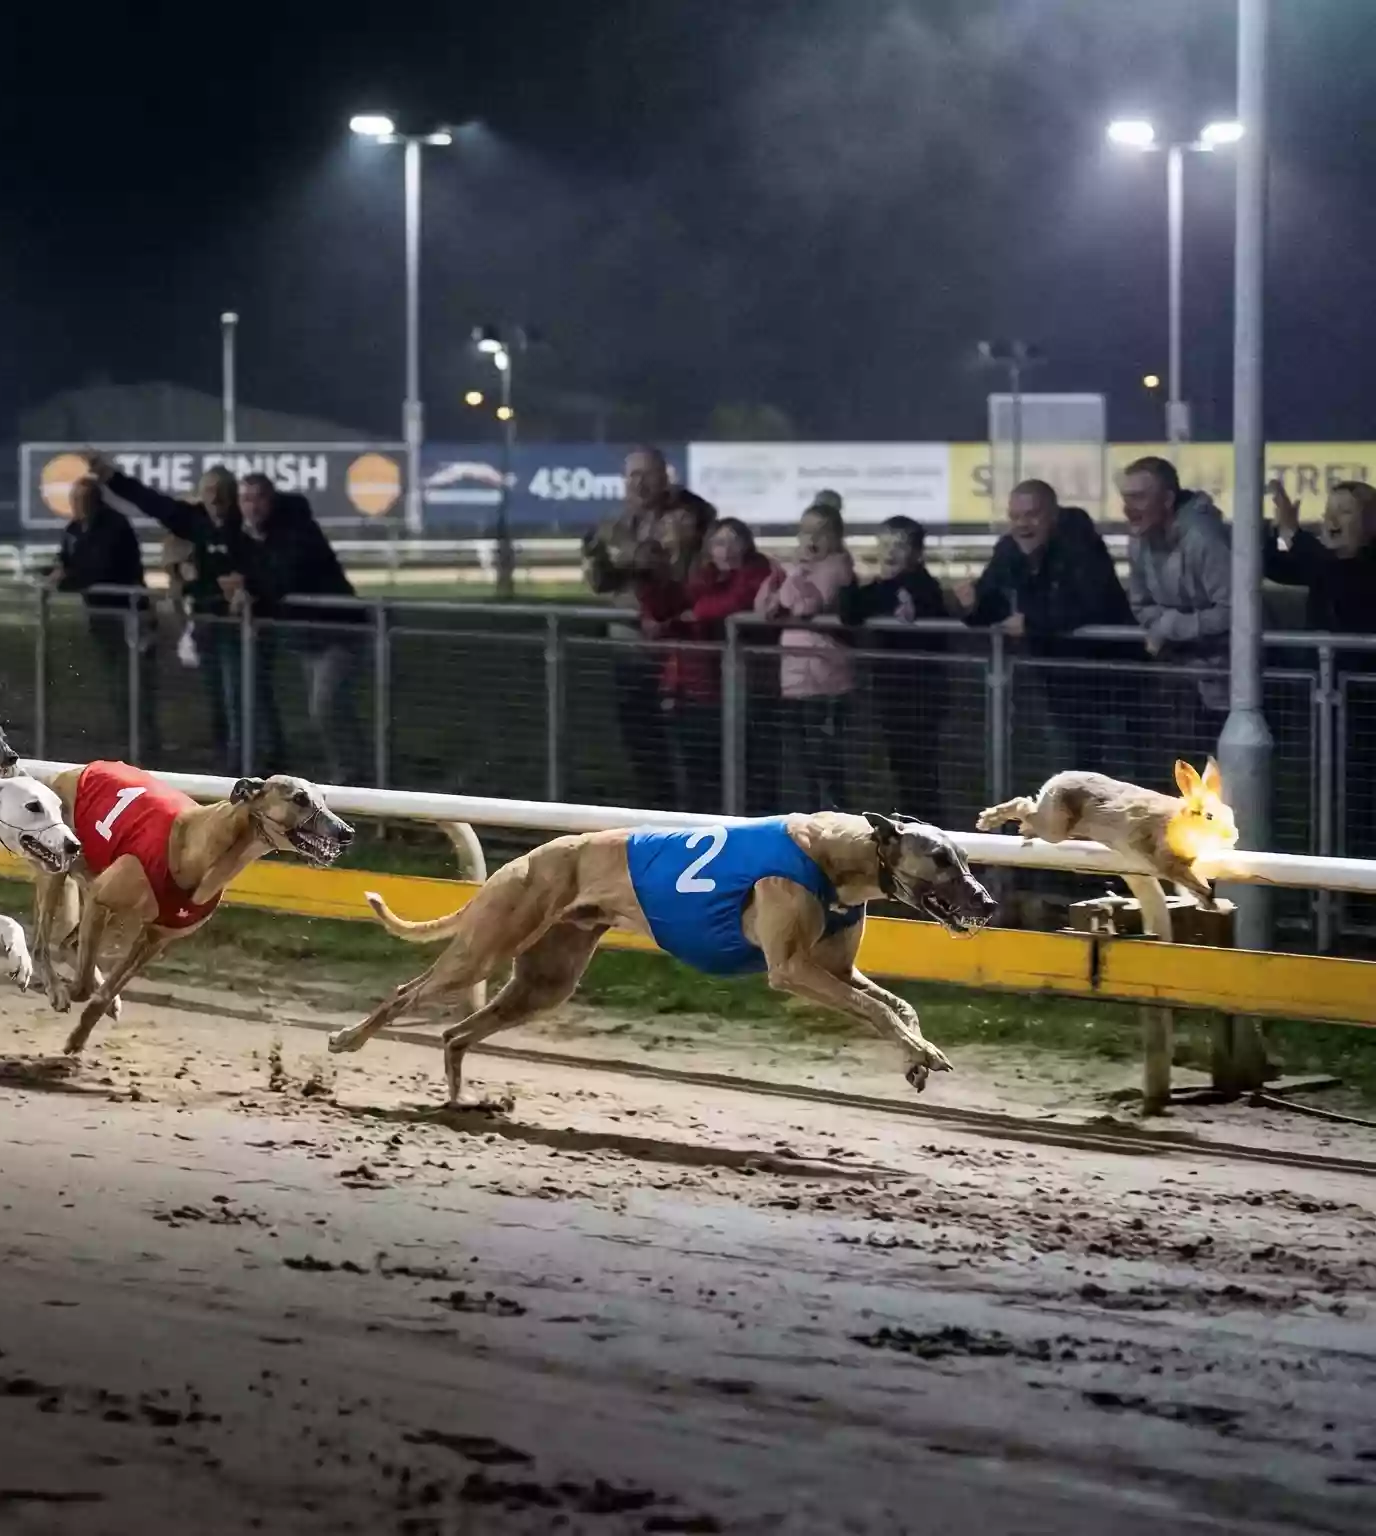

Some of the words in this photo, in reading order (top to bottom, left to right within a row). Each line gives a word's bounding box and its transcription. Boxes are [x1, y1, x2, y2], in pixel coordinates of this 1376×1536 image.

[114, 453, 194, 491] THE
[529, 467, 627, 500] 450m
[95, 787, 147, 842] 1
[675, 824, 728, 893] 2
